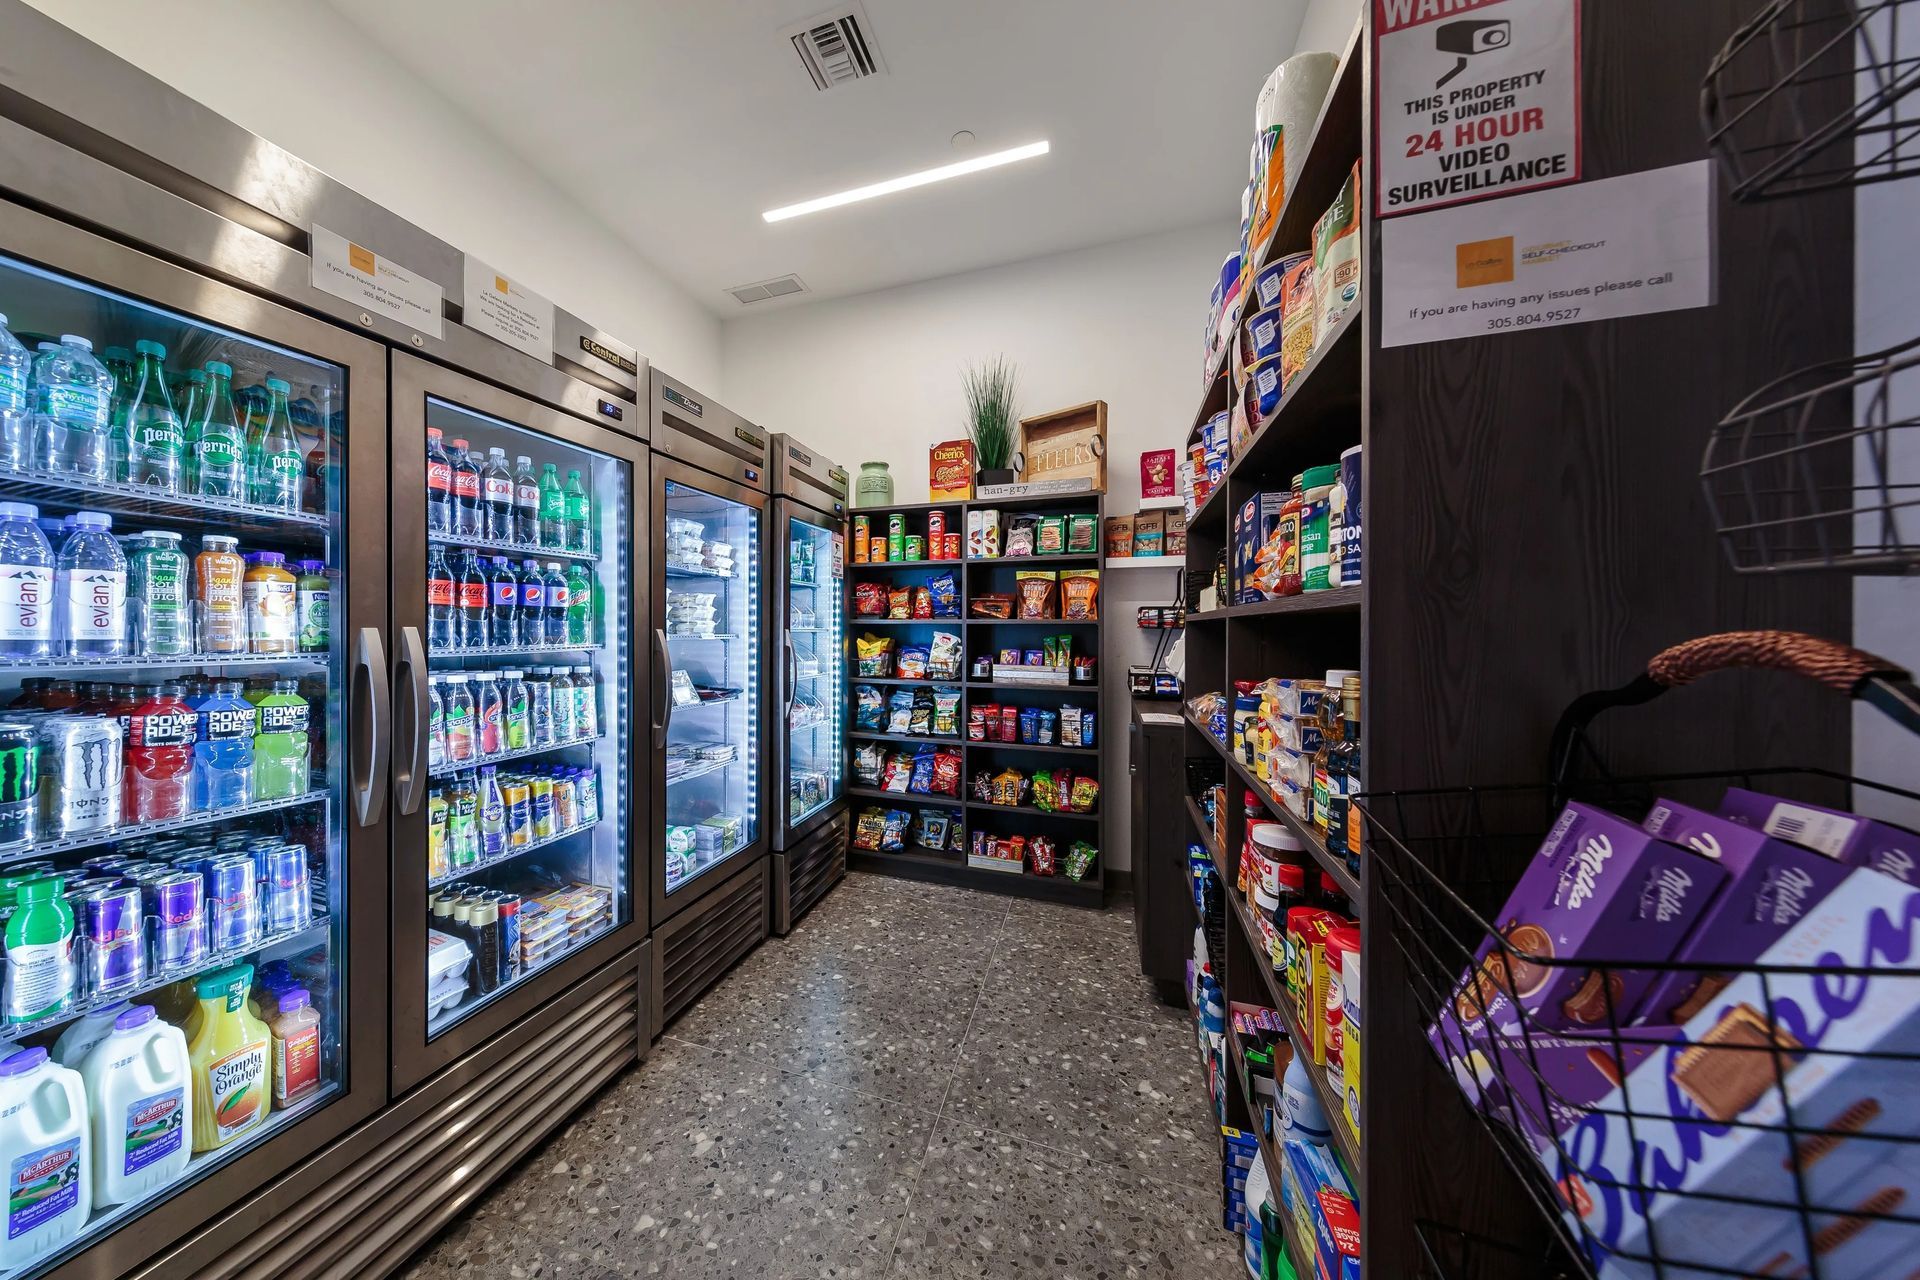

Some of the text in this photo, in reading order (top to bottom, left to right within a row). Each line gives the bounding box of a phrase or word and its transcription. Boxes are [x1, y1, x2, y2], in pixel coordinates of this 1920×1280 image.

[1404, 69, 1546, 115] THIS PROPERTY
[1432, 94, 1515, 125] IS UNDER
[1405, 107, 1544, 158] 24 HOUR
[1439, 142, 1510, 173] VIDEO
[1388, 153, 1566, 205] SURVEILLANCE
[1521, 240, 1606, 260] SELF-CHECKOUT
[332, 264, 344, 275] you
[356, 275, 376, 290] having
[1409, 272, 1673, 320] If you are having any issues please call
[1487, 308, 1581, 330] 305.804.9527
[590, 342, 620, 363] Central
[606, 403, 613, 413] 35
[143, 426, 184, 448] perri
[934, 450, 965, 461] Cheerios
[1037, 445, 1092, 472] FLEURS
[983, 485, 1029, 496] han-gry
[1111, 523, 1129, 531] GFB
[1139, 522, 1158, 530] GFB
[1347, 543, 1361, 554] SA
[16, 582, 38, 627] evian
[89, 585, 109, 628] evian
[146, 713, 198, 726] POWER
[209, 709, 257, 722] POWER
[263, 705, 310, 717] POWER
[263, 715, 292, 727] ADE
[145, 726, 182, 738] ADE
[209, 720, 243, 733] ADE
[861, 819, 881, 828] HARIBO
[1567, 834, 1613, 910] Milka
[1655, 866, 1693, 922] Milka
[1771, 866, 1814, 925] Milka
[1344, 1020, 1361, 1043] SUGA
[216, 1052, 262, 1083] Simply
[215, 1063, 262, 1096] Orange
[137, 1099, 177, 1122] McARTHUR
[22, 1151, 71, 1180] McARTHUR
[21, 1199, 50, 1217] Reduced
[49, 1193, 60, 1204] Fat
[61, 1185, 75, 1198] Milk
[1334, 1231, 1361, 1243] RAGE
